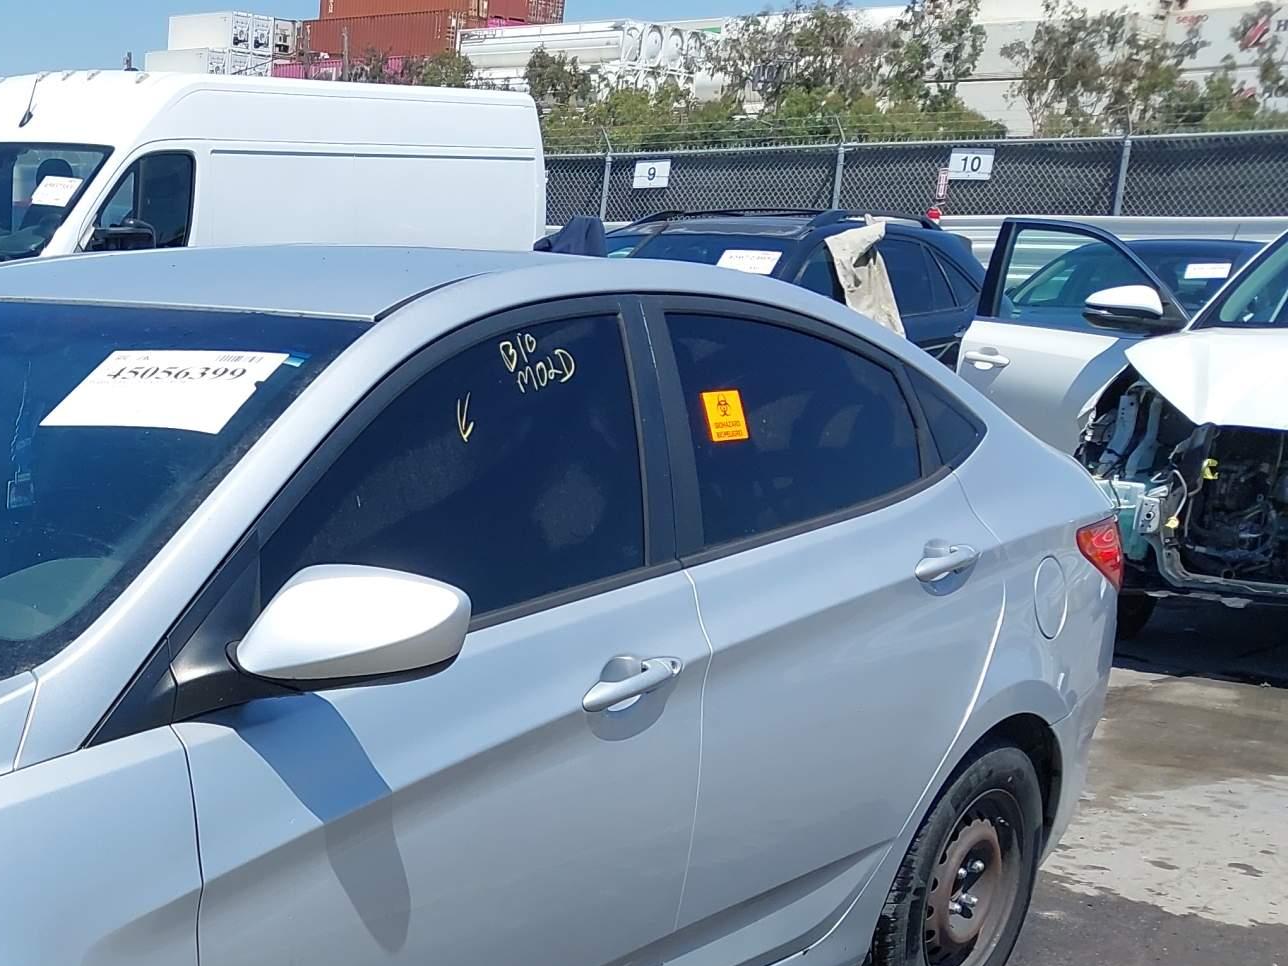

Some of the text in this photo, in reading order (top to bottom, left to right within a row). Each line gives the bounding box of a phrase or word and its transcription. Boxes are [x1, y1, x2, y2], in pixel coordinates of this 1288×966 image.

[960, 155, 982, 173] 10
[647, 166, 657, 181] 9
[106, 366, 247, 381] 45056399
